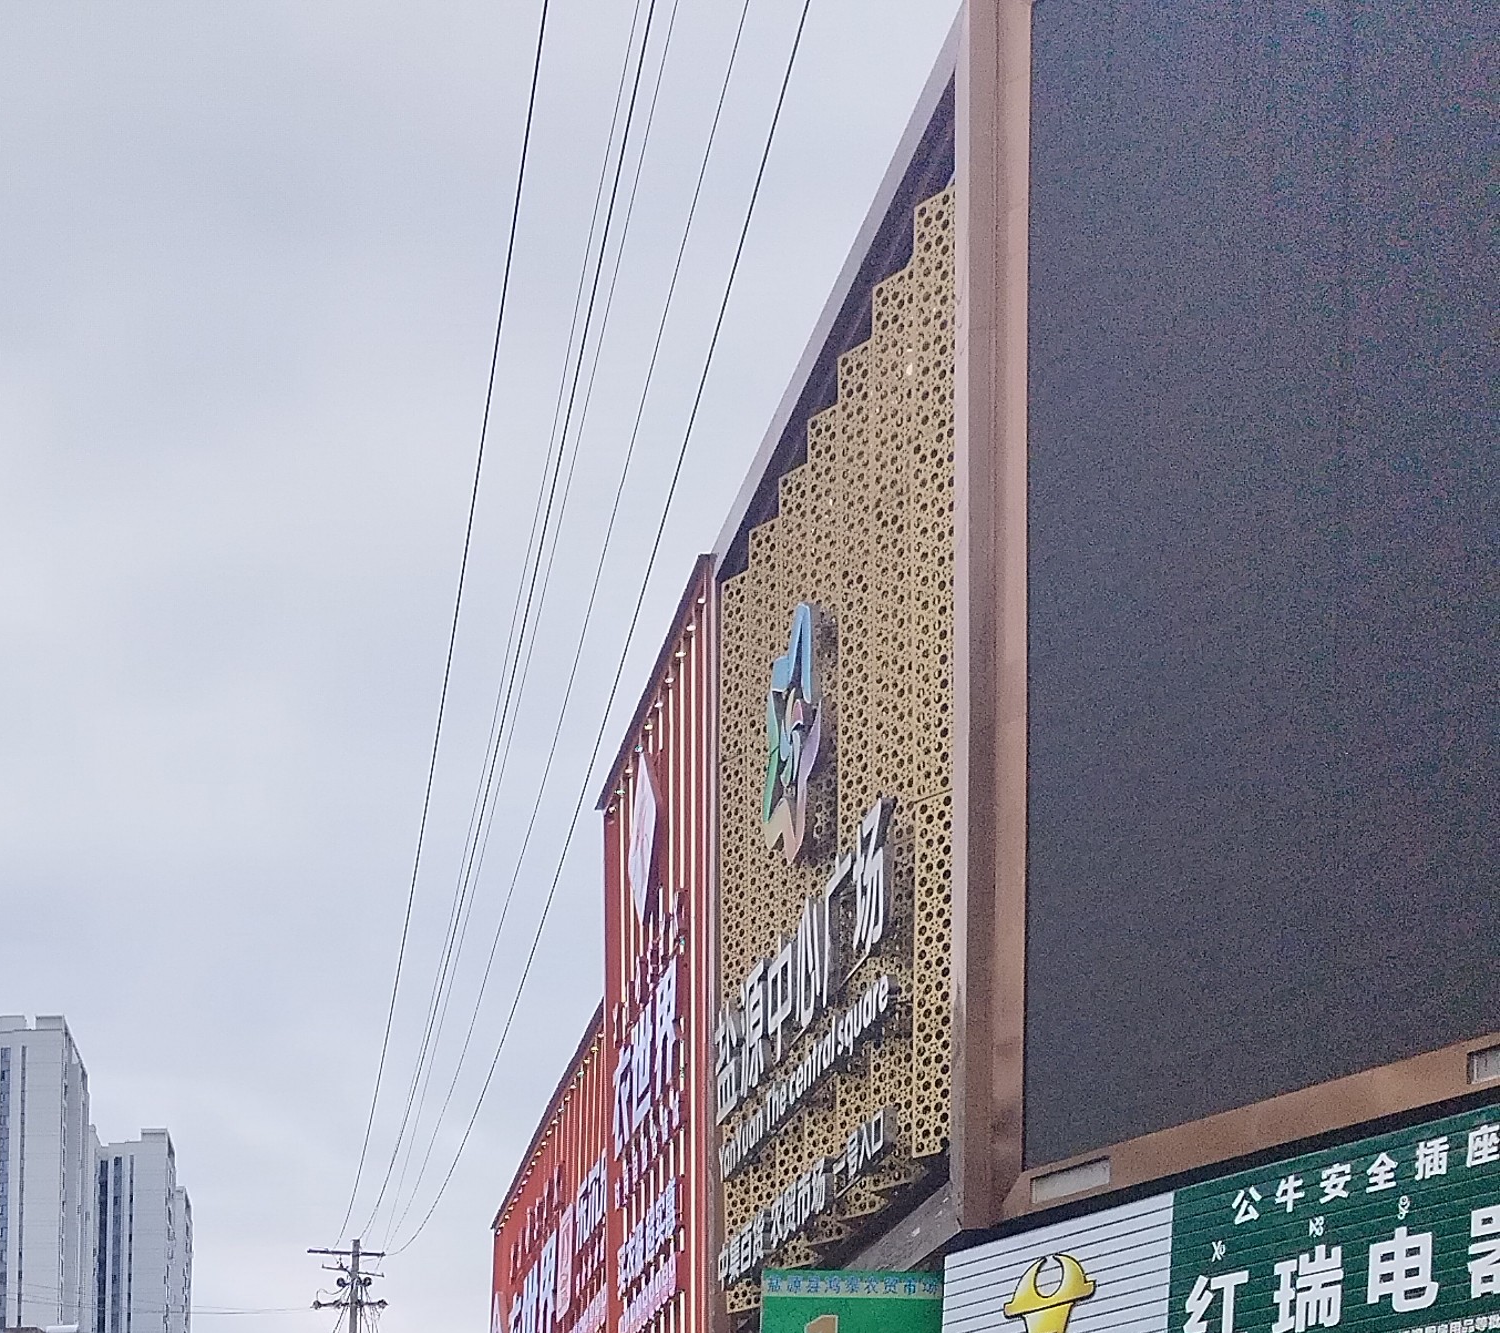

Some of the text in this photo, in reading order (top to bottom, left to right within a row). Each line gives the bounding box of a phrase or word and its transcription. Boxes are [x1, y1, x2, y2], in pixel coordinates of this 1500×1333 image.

[715, 797, 884, 1126] 盐源中心广场
[718, 974, 890, 1182] YanYuan The central square
[769, 1157, 826, 1249] 农贸市场
[832, 1109, 884, 1176] 一号入口
[1232, 1124, 1500, 1225] 公牛安全插座
